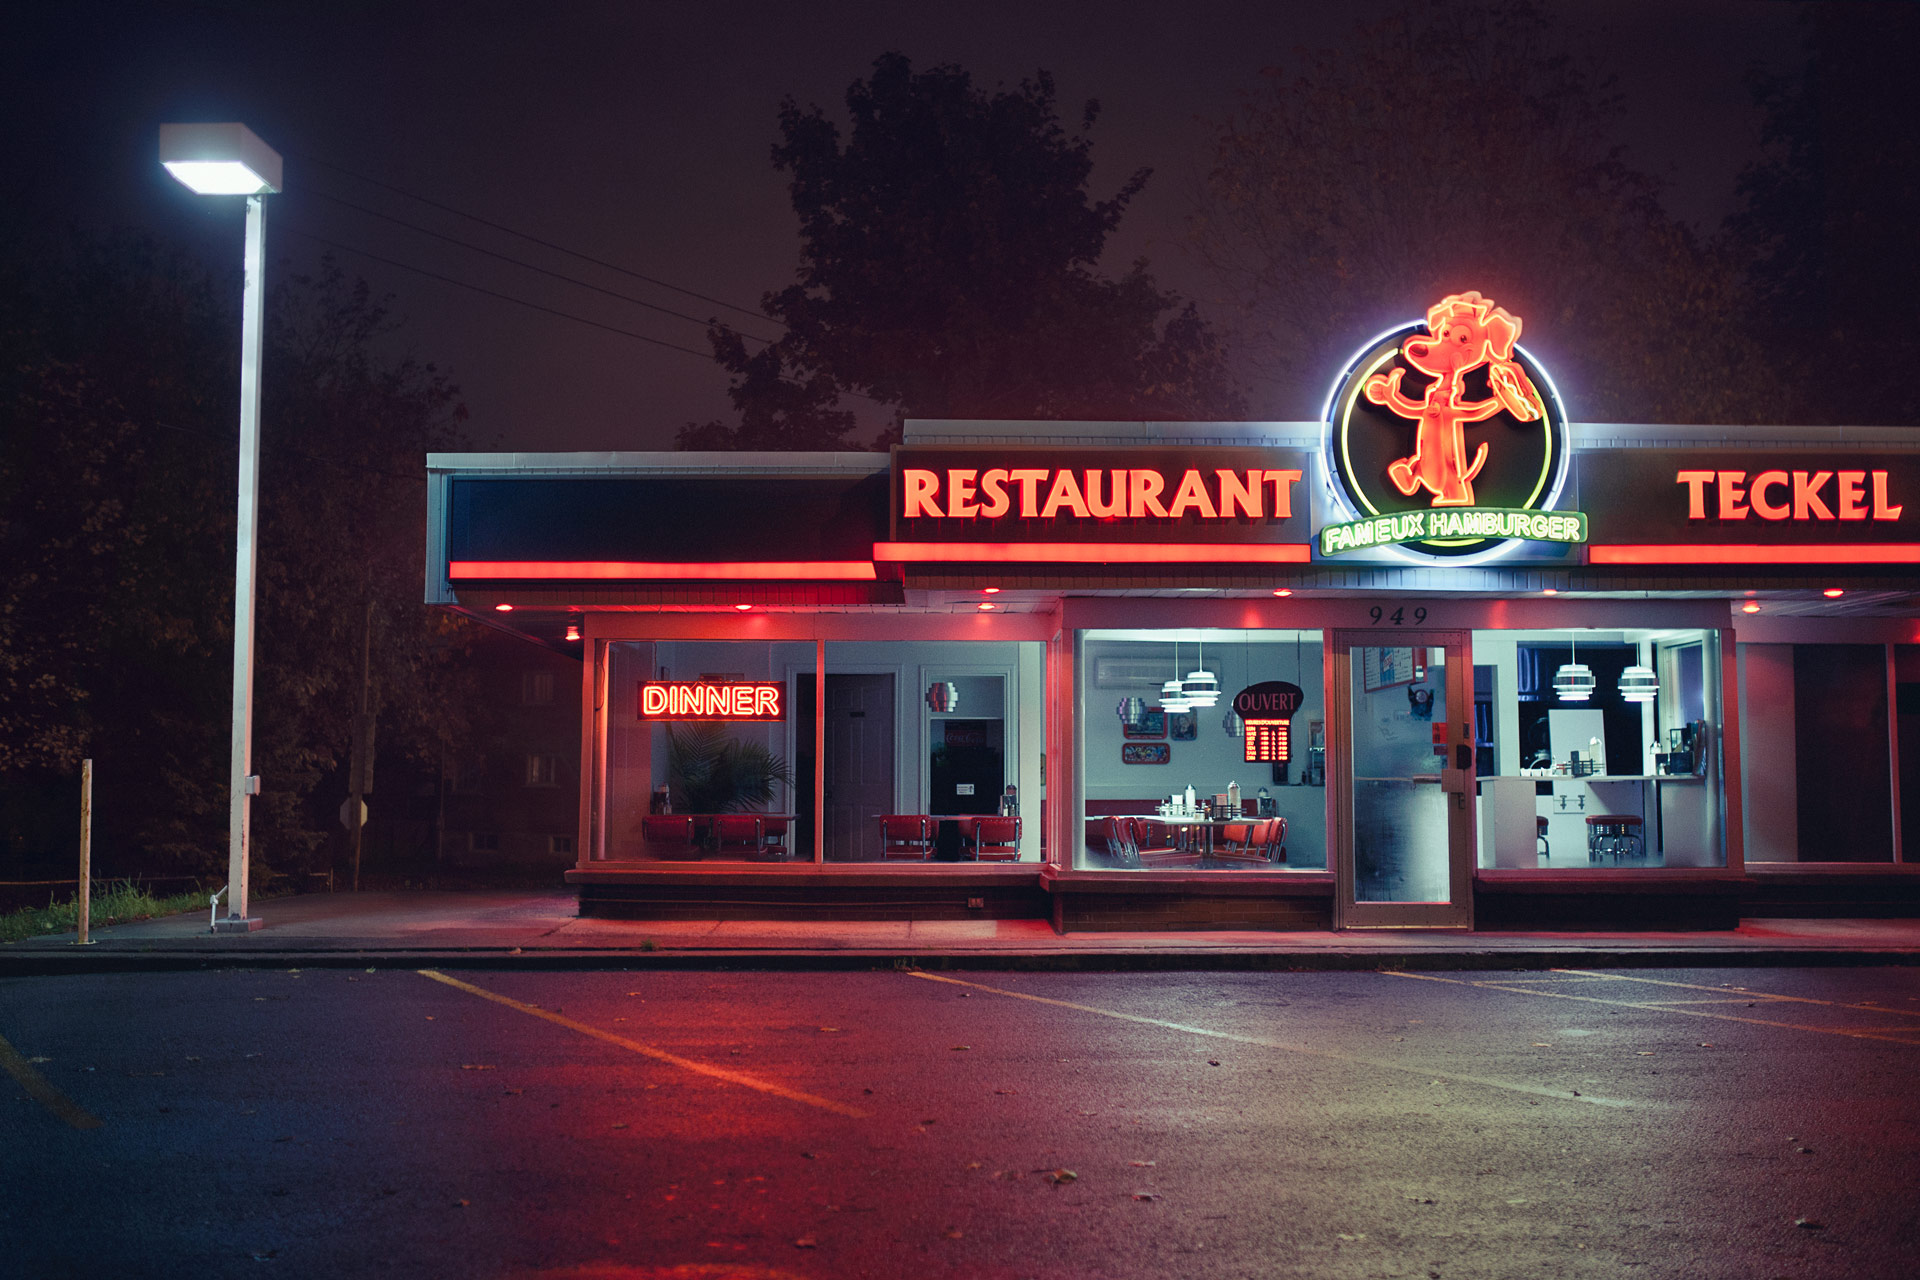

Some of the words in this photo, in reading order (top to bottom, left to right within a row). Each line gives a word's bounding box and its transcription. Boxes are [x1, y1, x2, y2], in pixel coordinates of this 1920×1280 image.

[903, 467, 1302, 520] RESTAURANT
[1676, 468, 1903, 521] TECKEL
[1325, 512, 1424, 553] FAMEUX
[1430, 512, 1580, 540] HAMBURGER
[1369, 606, 1428, 625] 949
[642, 683, 780, 716] DINNER
[1239, 693, 1296, 711] OUVERT
